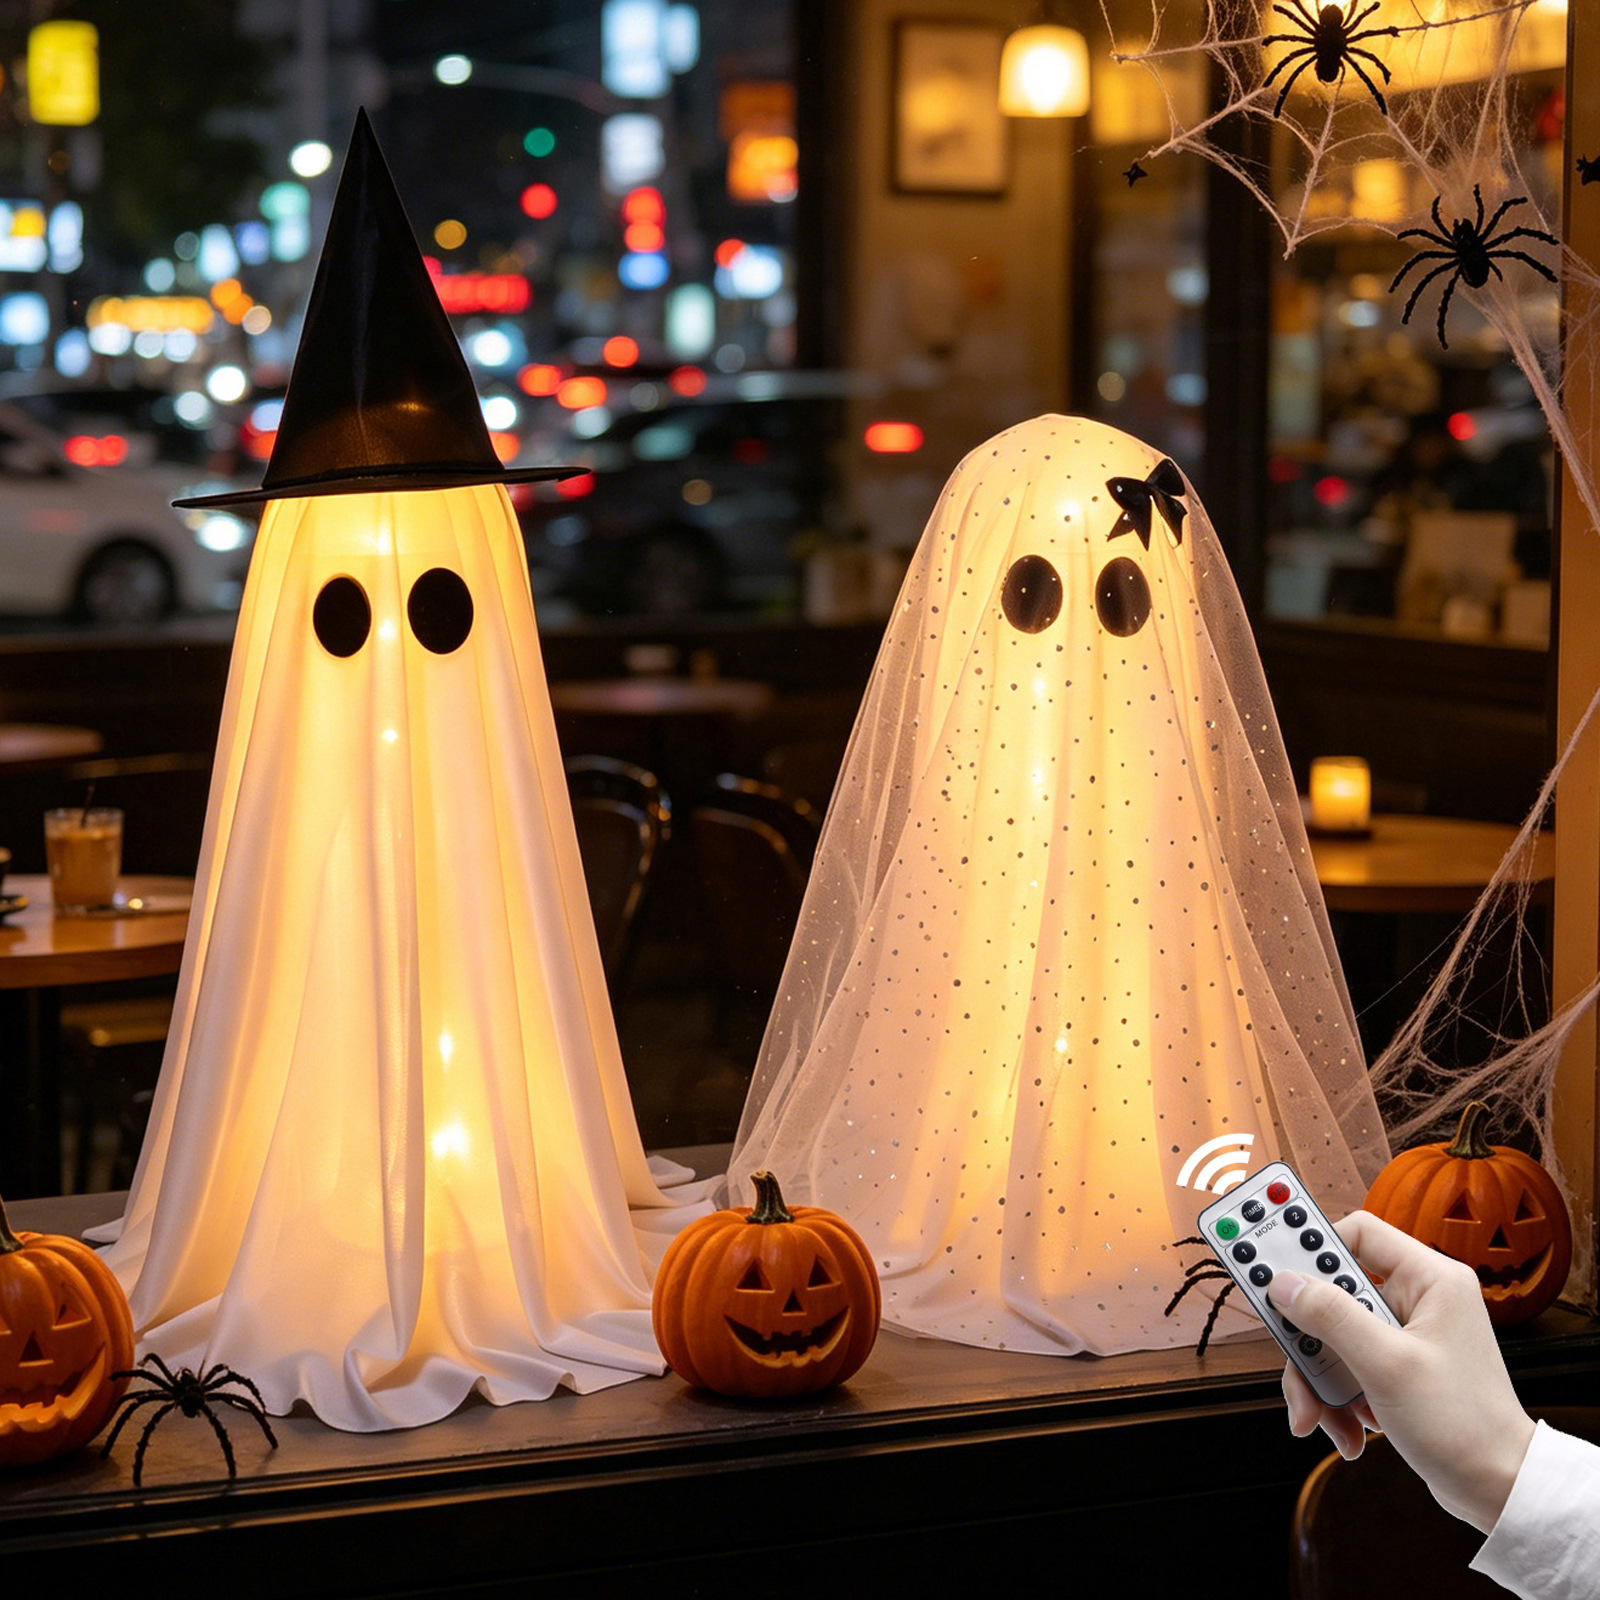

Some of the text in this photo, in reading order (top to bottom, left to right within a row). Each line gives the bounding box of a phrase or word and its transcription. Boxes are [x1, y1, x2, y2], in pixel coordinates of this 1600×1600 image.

[1270, 1184, 1288, 1200] OFF
[1243, 1202, 1265, 1219] TIMER
[1292, 1211, 1300, 1221] 2
[1221, 1221, 1236, 1235] ON
[1254, 1219, 1279, 1238] MODE
[1241, 1247, 1248, 1255] 1
[1325, 1258, 1332, 1266] 6
[1257, 1271, 1265, 1279] 3
